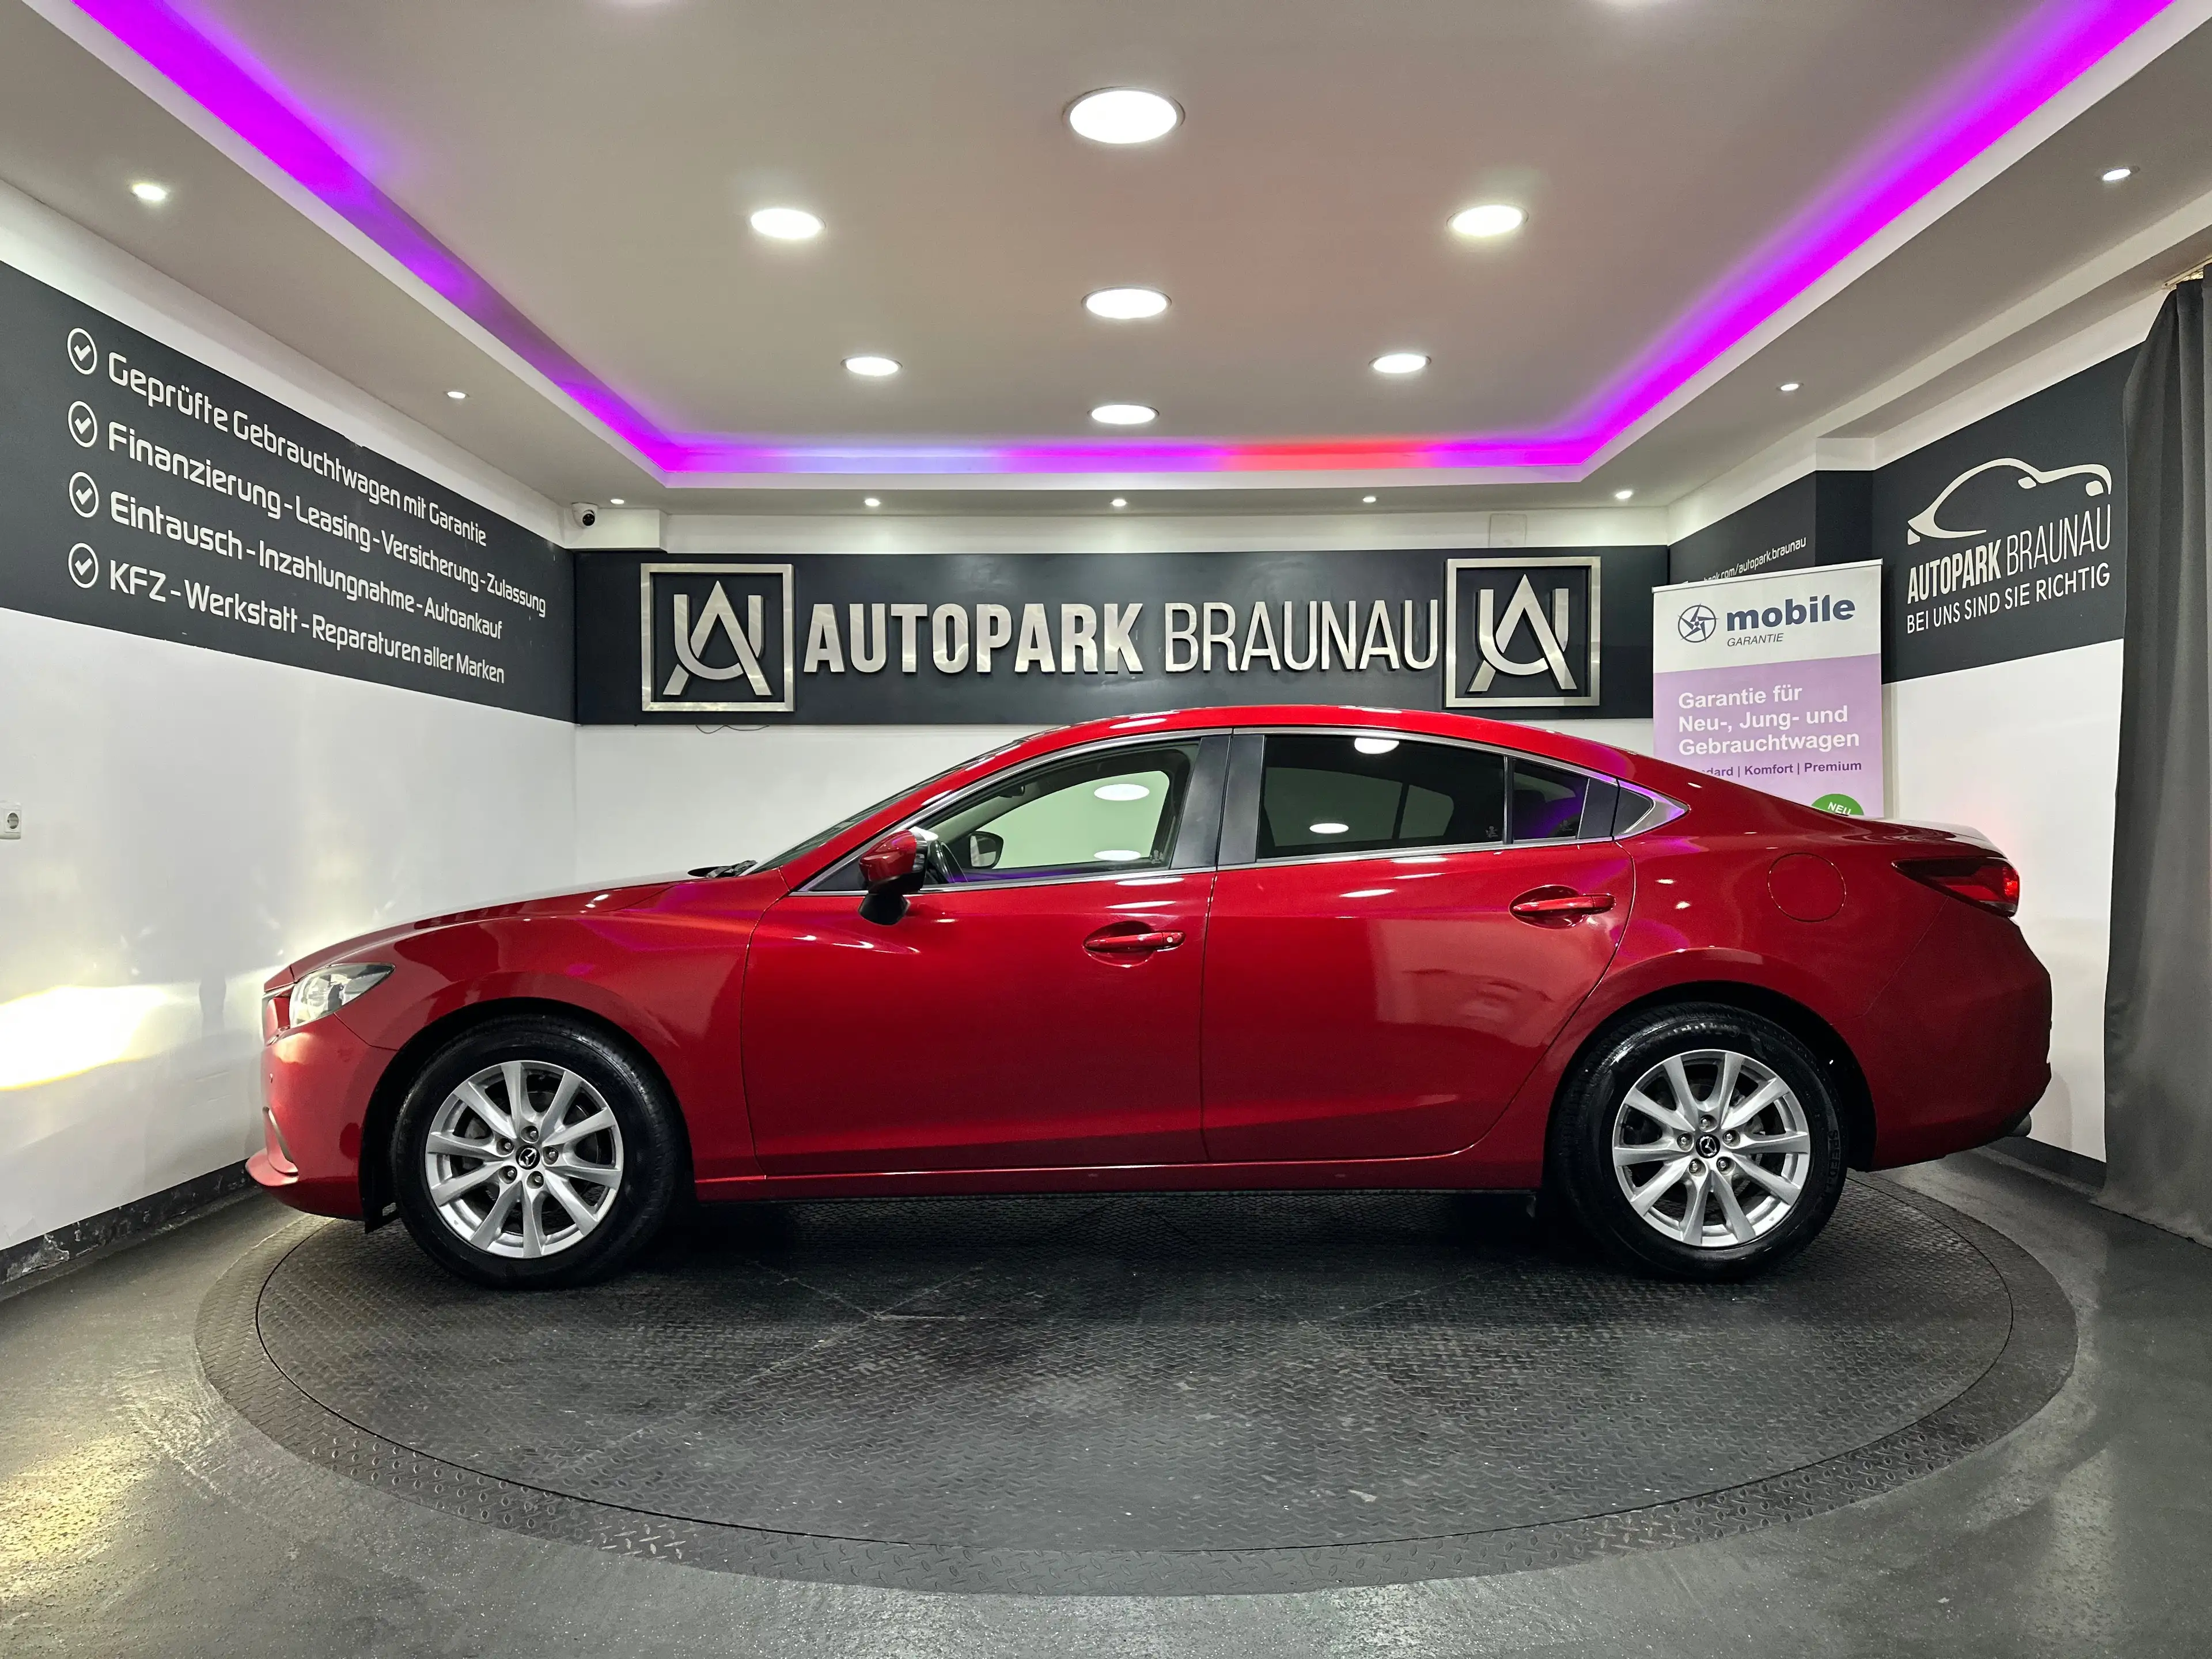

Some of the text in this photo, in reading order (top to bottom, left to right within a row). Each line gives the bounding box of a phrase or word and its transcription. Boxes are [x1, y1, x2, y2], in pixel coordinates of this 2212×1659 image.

[108, 352, 487, 547] Geprüfte Gebrauchtwagen mit Garantie
[1907, 503, 2111, 604] AUTOPARK BRAUNAU
[1726, 594, 1855, 631] mobile
[1907, 562, 2111, 634] BEI UNS SIND SIE RICHTIG
[312, 613, 421, 664] Reparaturen
[423, 646, 454, 671] aller
[456, 652, 505, 684] Marken
[803, 599, 1439, 673] AUTOPARK BRAUNAU
[1727, 632, 1784, 647] GARANTIE
[1679, 684, 1803, 709] Garantie für
[1679, 705, 1848, 733] Neu-, Jung- und
[1679, 733, 1859, 756] Gebrauchtwagen
[1744, 763, 1794, 775] Komfort
[1804, 762, 1862, 772] Premium
